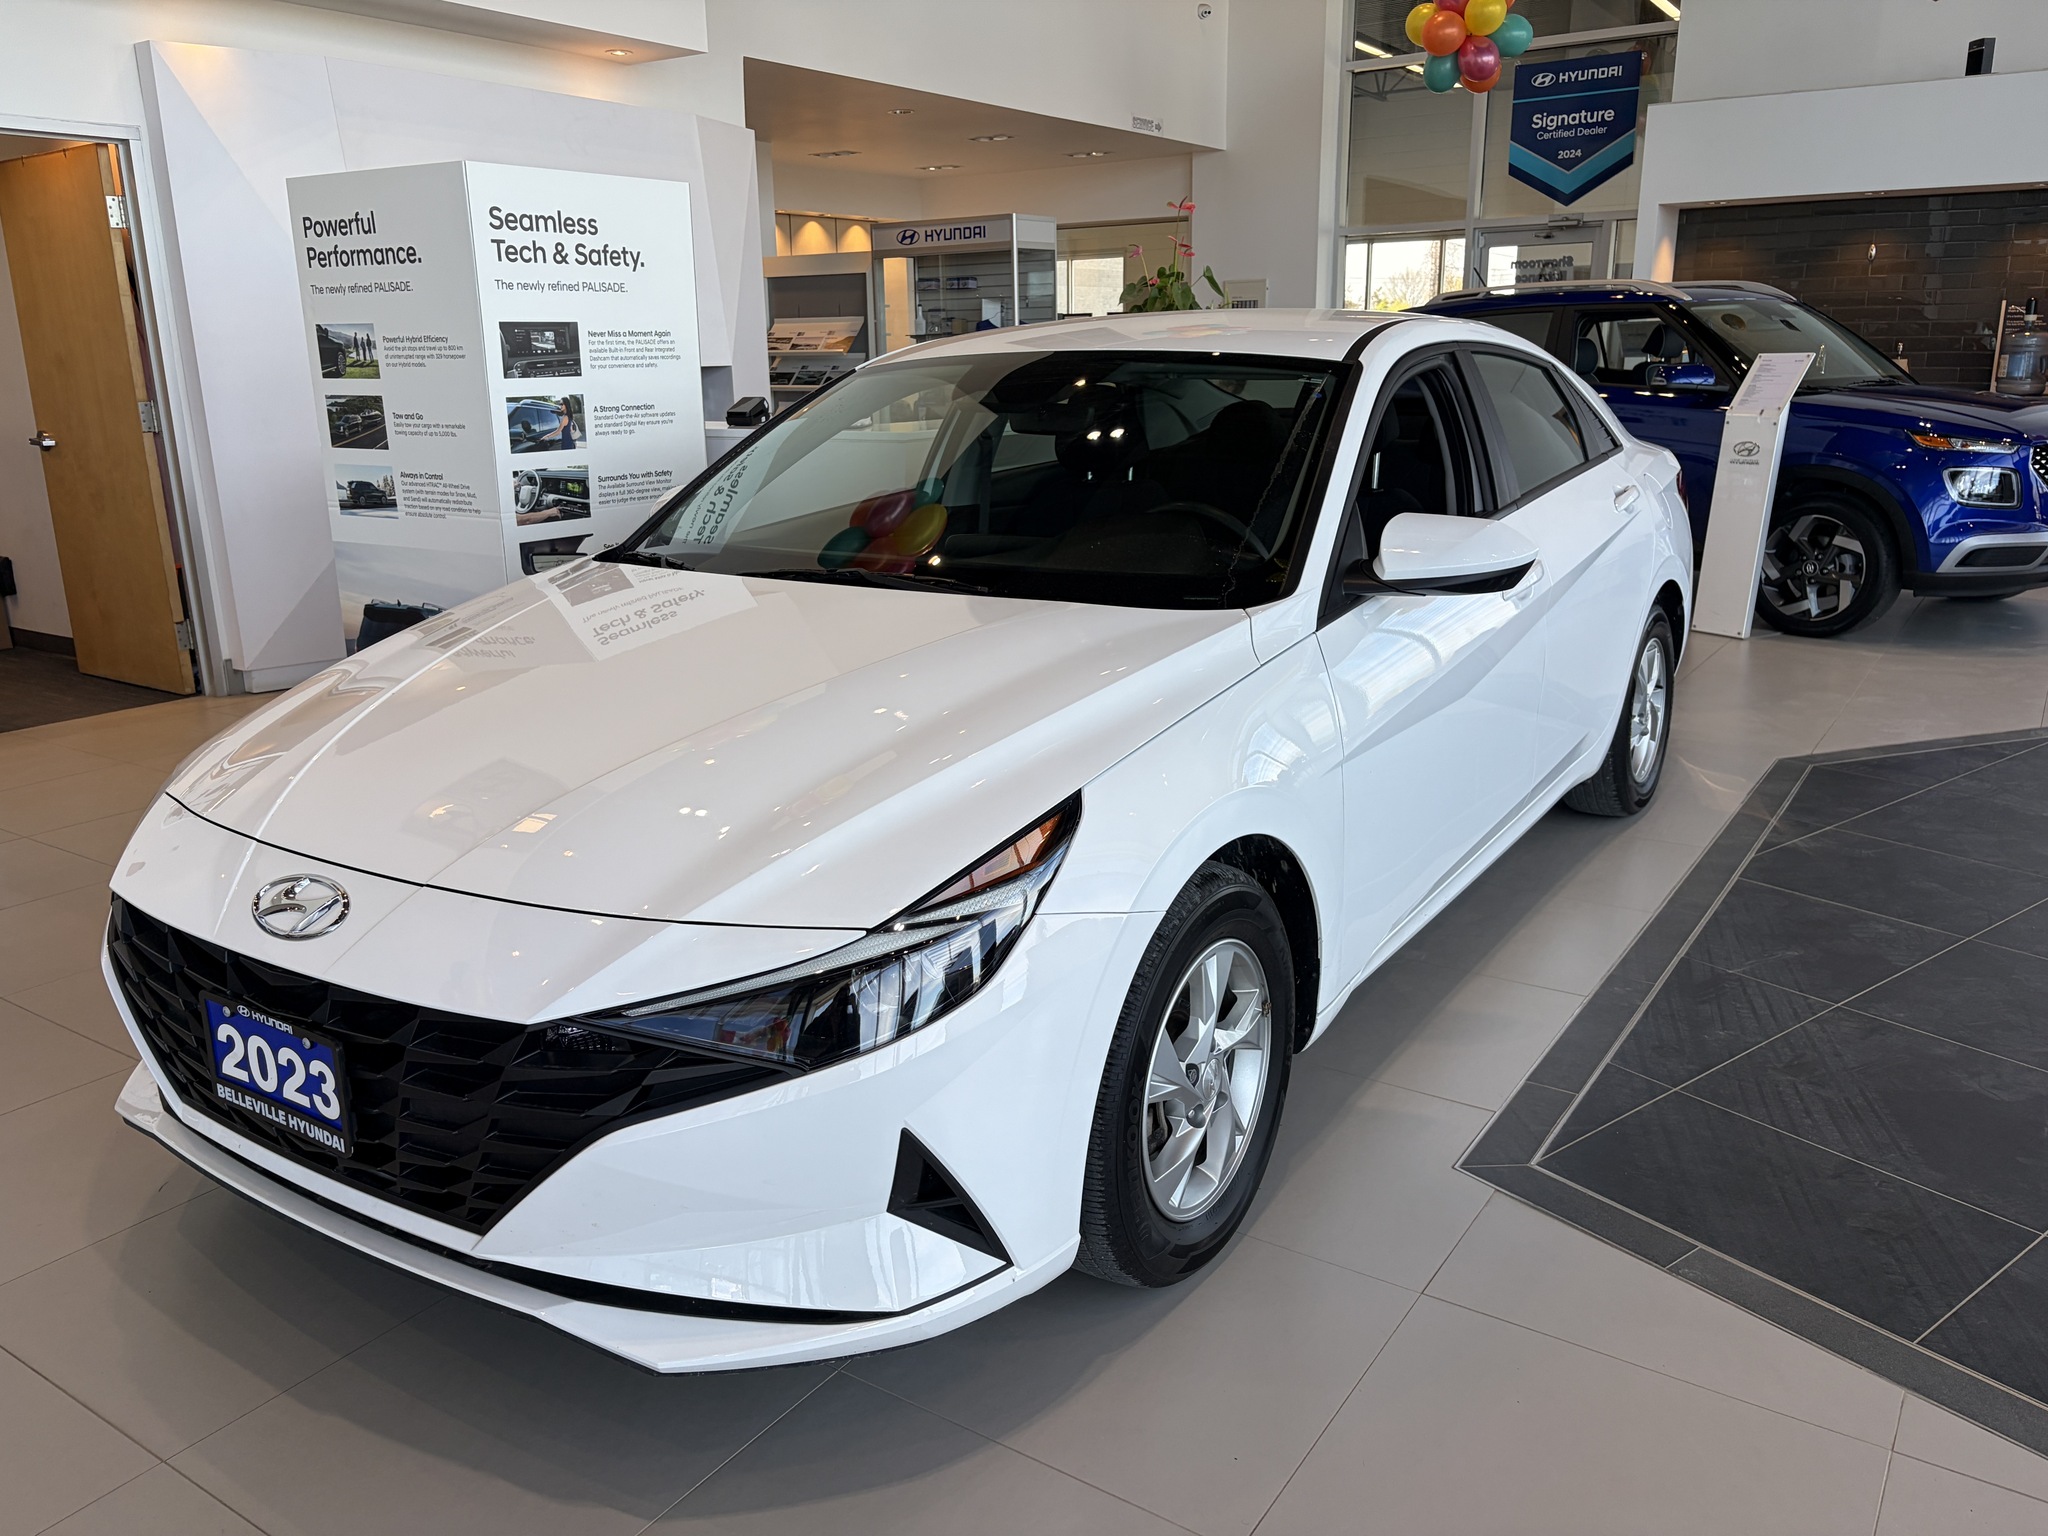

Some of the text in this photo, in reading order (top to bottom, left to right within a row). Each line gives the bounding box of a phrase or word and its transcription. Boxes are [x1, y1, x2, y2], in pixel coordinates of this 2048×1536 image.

[1559, 66, 1623, 83] HYUNDAI
[1532, 109, 1615, 130] Signature
[1537, 126, 1608, 140] Certified Dealer
[1558, 149, 1582, 159] 2024
[302, 211, 377, 238] Powerful
[489, 206, 598, 236] Seamless
[925, 225, 986, 242] HYUNDAI
[306, 244, 422, 268] Performance.
[491, 239, 645, 272] Tech & Safety.
[310, 281, 413, 296] The newly refined PALISADE.
[495, 280, 628, 293] The newly refined PALISADE.
[406, 335, 422, 344] Hybrid
[423, 335, 448, 344] Efficiency
[654, 330, 671, 338] Again
[600, 405, 620, 413] Strong
[621, 403, 655, 411] Connection
[400, 472, 418, 480] Always
[598, 474, 628, 483] Surrounds
[654, 470, 673, 478] Safety
[252, 1011, 293, 1035] HYUNDAI
[217, 1024, 341, 1120] 2023
[217, 1083, 345, 1153] BELLEVILLE HYUNDAI
